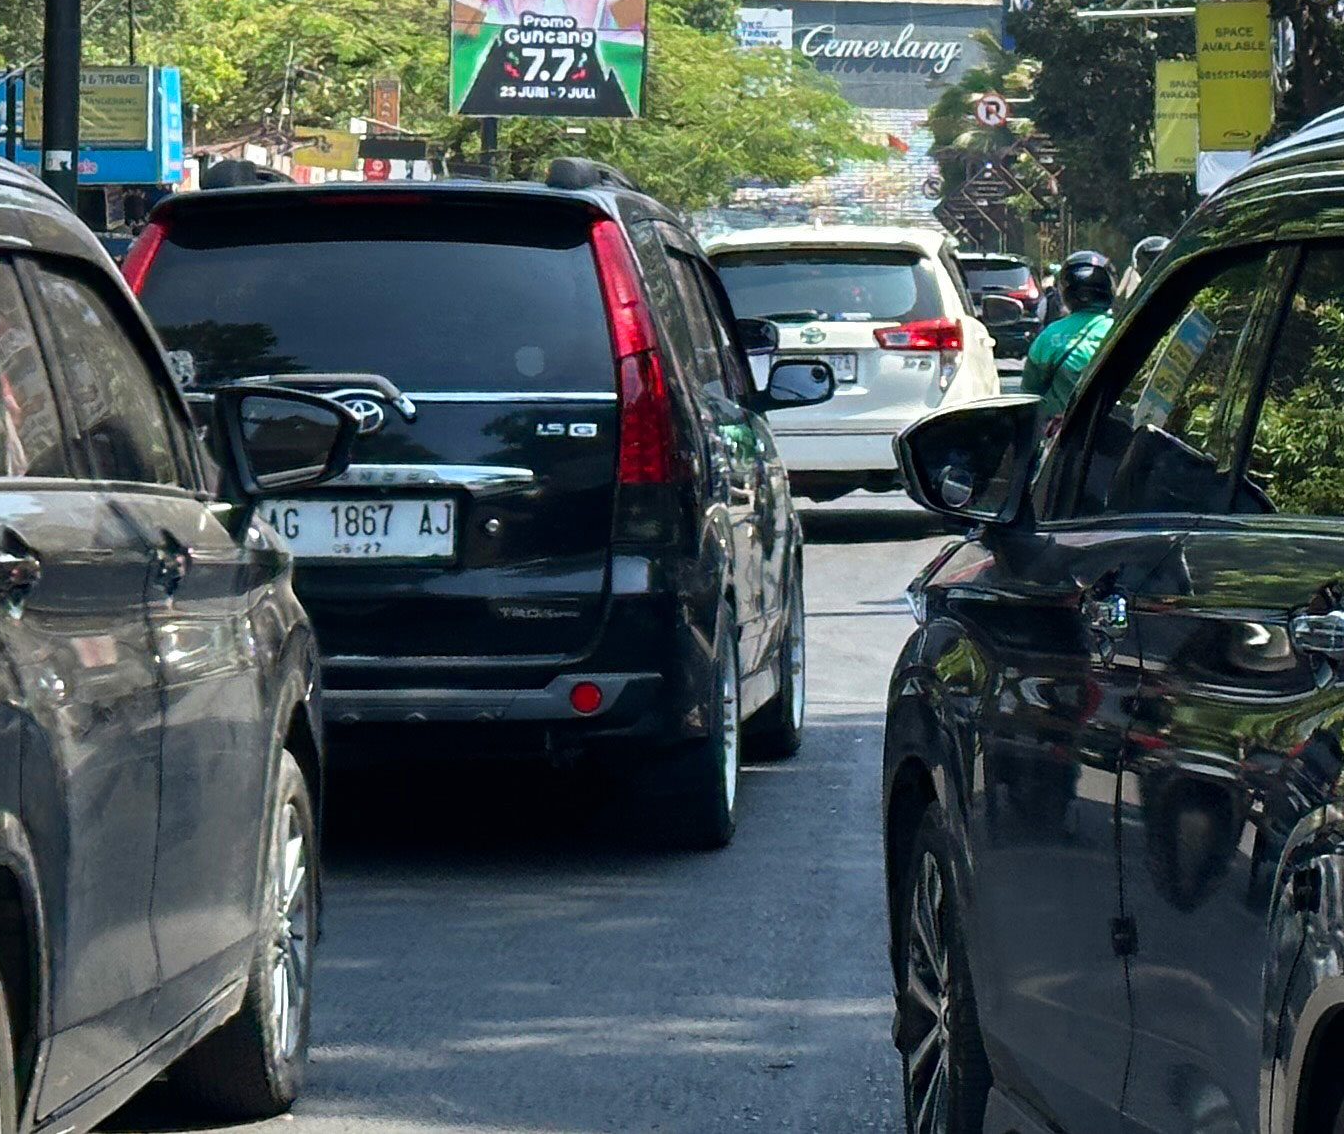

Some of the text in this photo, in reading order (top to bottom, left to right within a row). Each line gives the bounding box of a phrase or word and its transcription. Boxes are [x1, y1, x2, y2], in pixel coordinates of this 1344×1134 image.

[523, 15, 574, 27] Promo
[505, 29, 595, 48] Guncang
[1215, 27, 1254, 37] SPACE
[801, 23, 962, 73] Cemerlang
[1201, 41, 1266, 52] AVAILABLE
[521, 48, 575, 82] 7.7
[98, 73, 143, 85] TRAVEL
[499, 86, 517, 97] 25
[518, 87, 549, 98] JUNI
[568, 88, 596, 99] JULI
[331, 504, 394, 538] 1867
[419, 503, 452, 536] AJ
